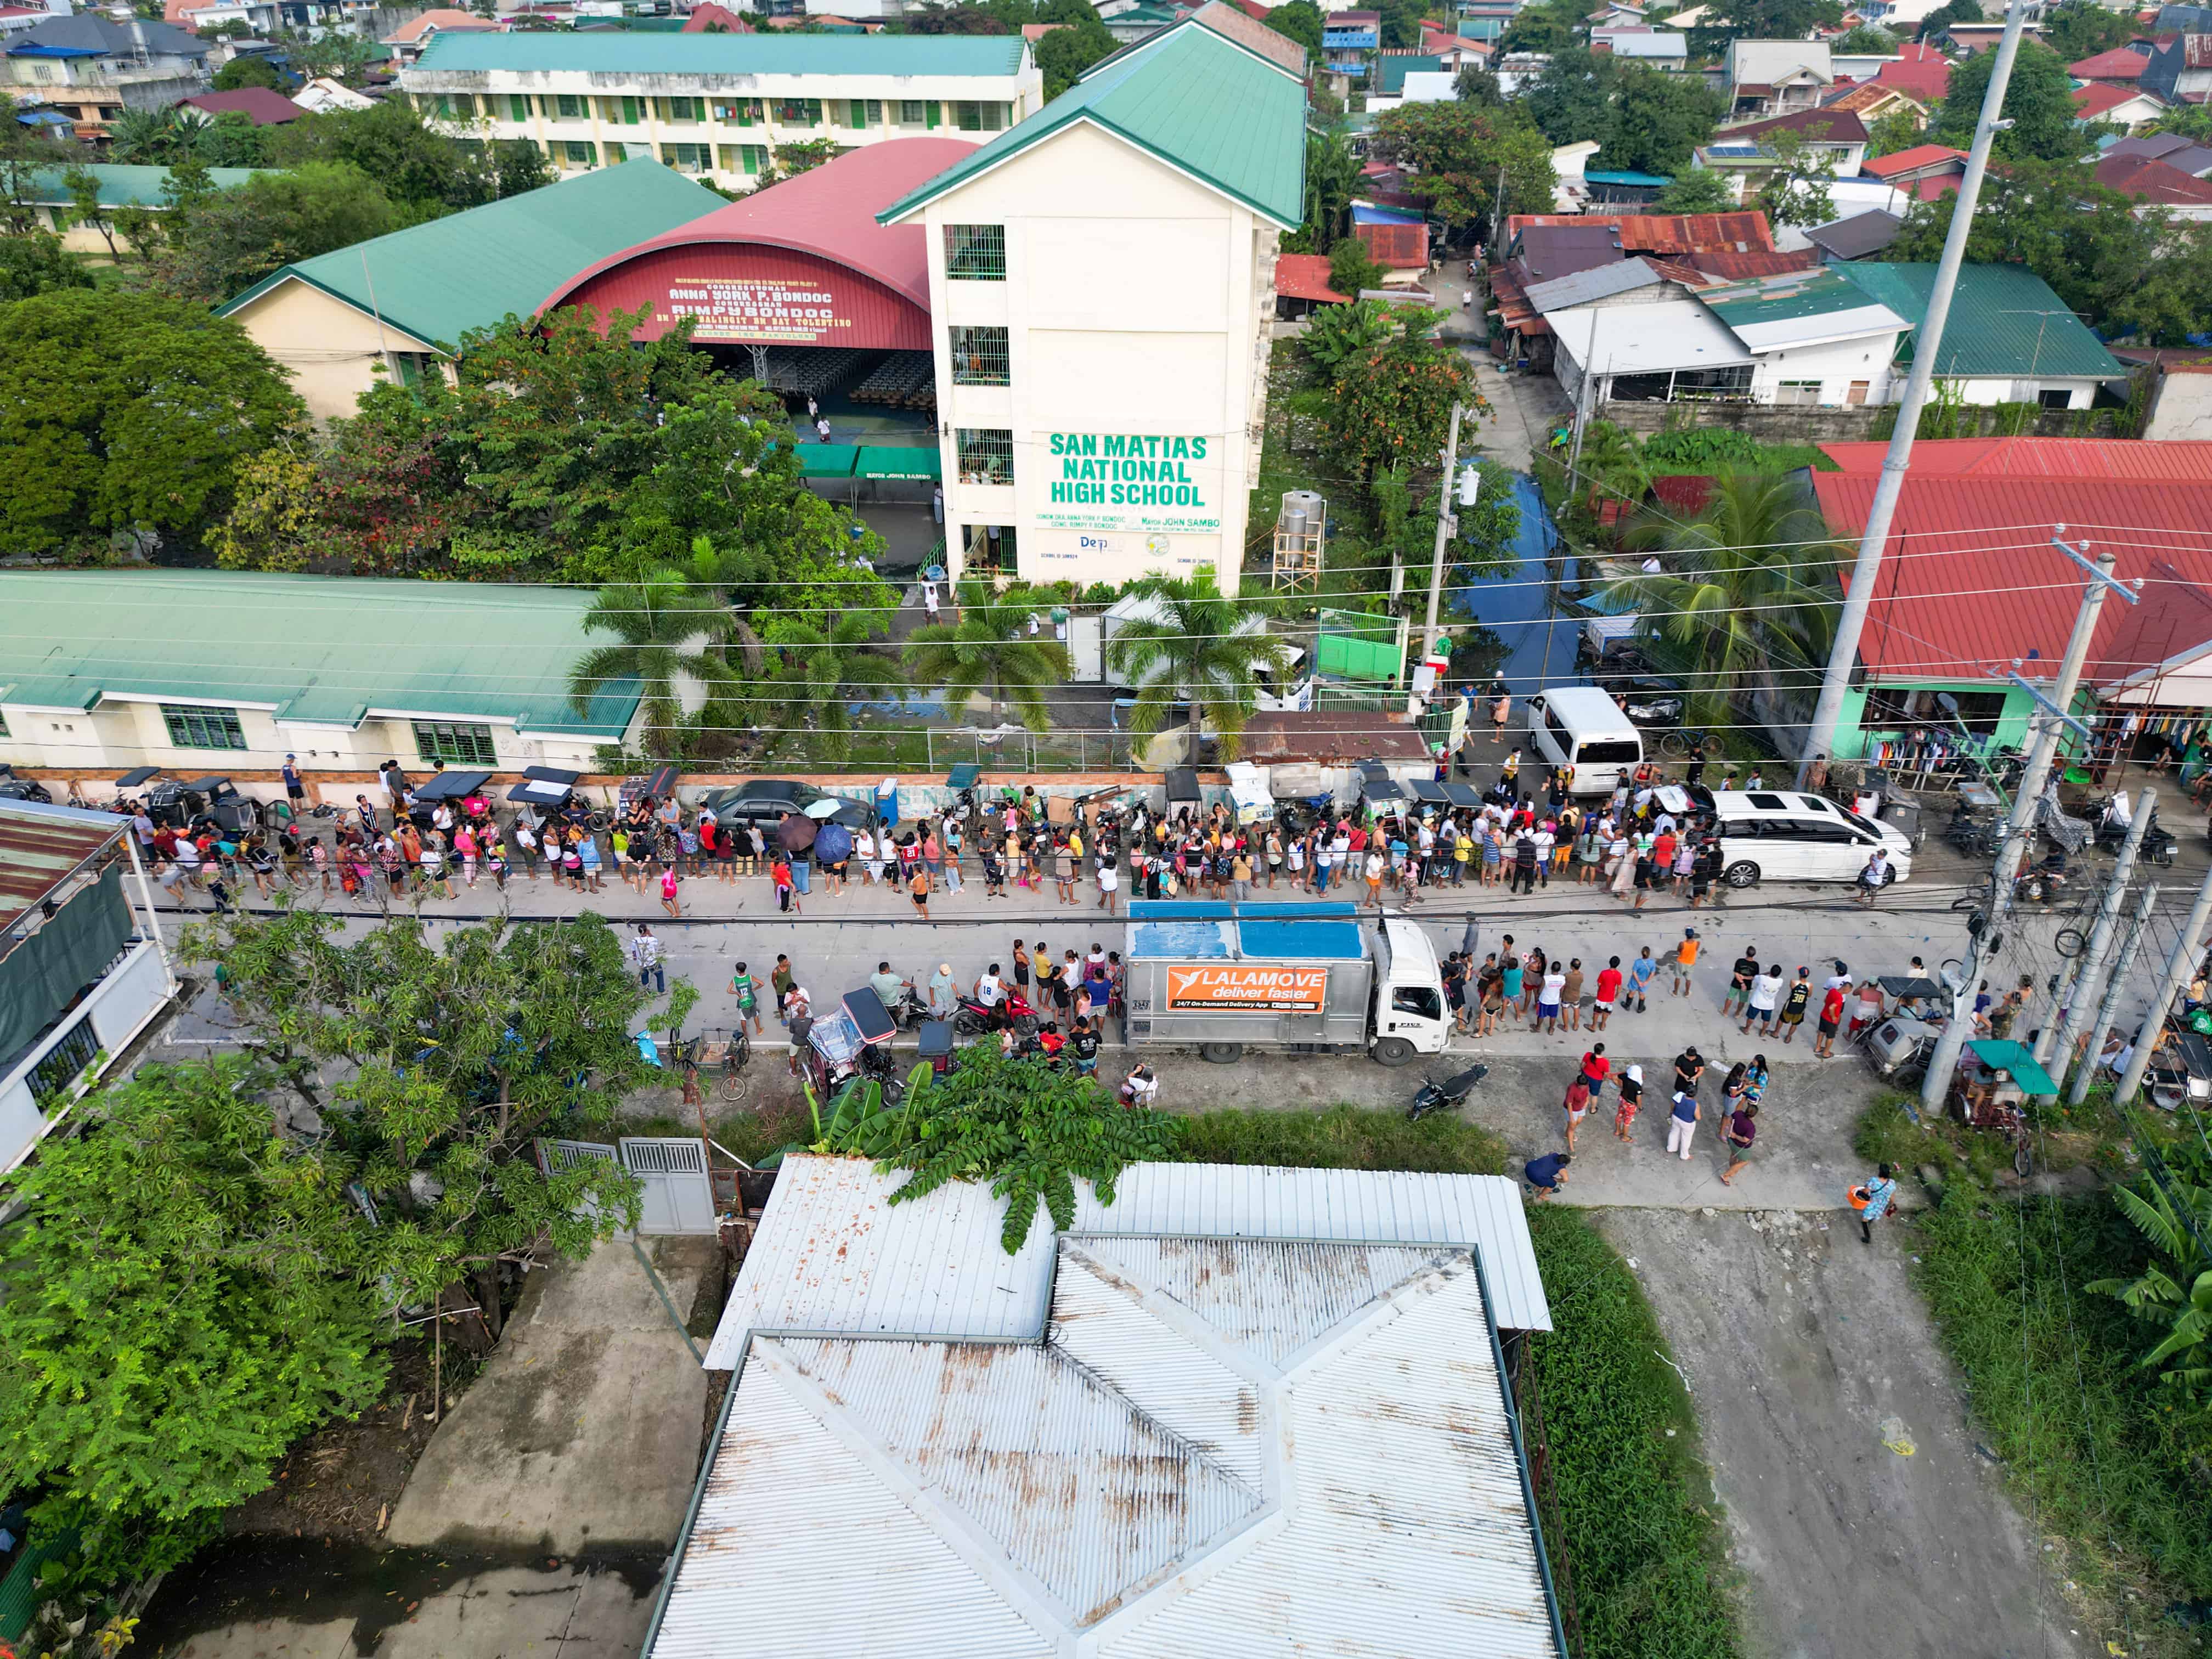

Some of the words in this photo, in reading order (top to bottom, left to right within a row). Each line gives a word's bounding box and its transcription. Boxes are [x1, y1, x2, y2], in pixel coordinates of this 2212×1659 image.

[669, 289, 708, 300] ANNA
[713, 290, 752, 301] YORK
[772, 292, 832, 303] BONDOC
[795, 318, 851, 327] TOLENTINO
[1050, 433, 1096, 456] SAN
[1104, 435, 1206, 460] MATIAS
[1063, 458, 1191, 483] NATIONAL
[1051, 482, 1105, 504] HIGH
[1111, 484, 1205, 506] SCHOOL
[1163, 518, 1184, 526] JOHN
[1187, 519, 1220, 527] SAMBO
[1202, 971, 1324, 987] LALAMOVE
[740, 988, 748, 996] 12
[984, 986, 991, 995] 18
[1212, 986, 1265, 998] deliver
[1267, 987, 1311, 1000] faster
[1792, 994, 1805, 1003] 38
